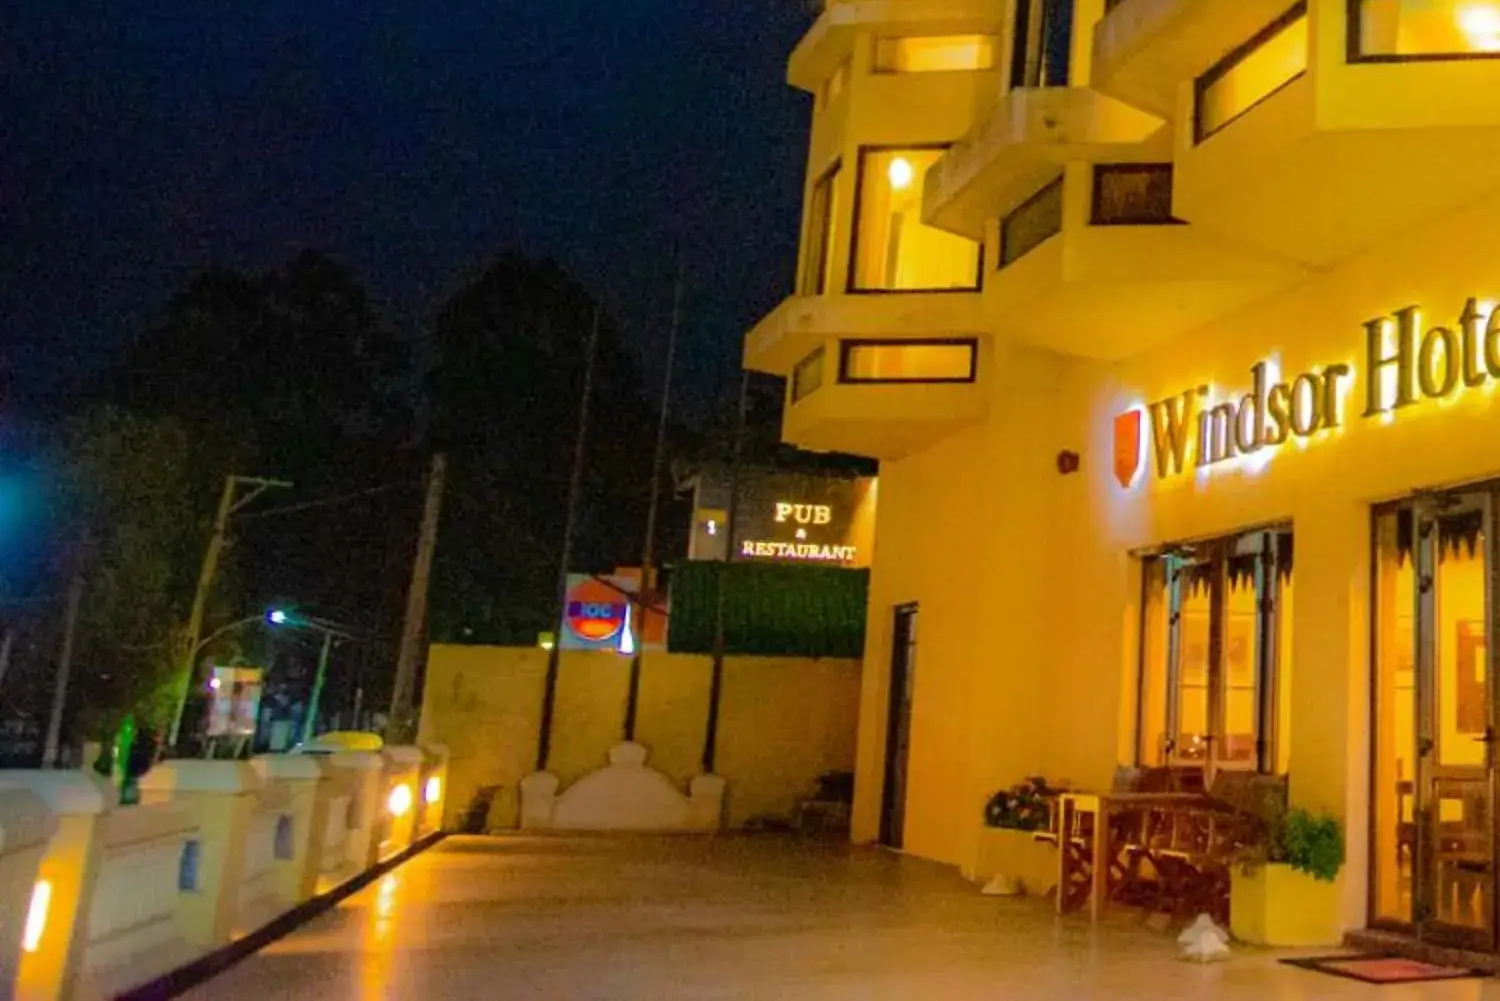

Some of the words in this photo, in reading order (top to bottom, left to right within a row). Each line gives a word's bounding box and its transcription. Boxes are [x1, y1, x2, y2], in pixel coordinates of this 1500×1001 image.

[1149, 359, 1349, 478] Windsor
[775, 502, 831, 524] PUB
[742, 541, 856, 560] RESTAURANT
